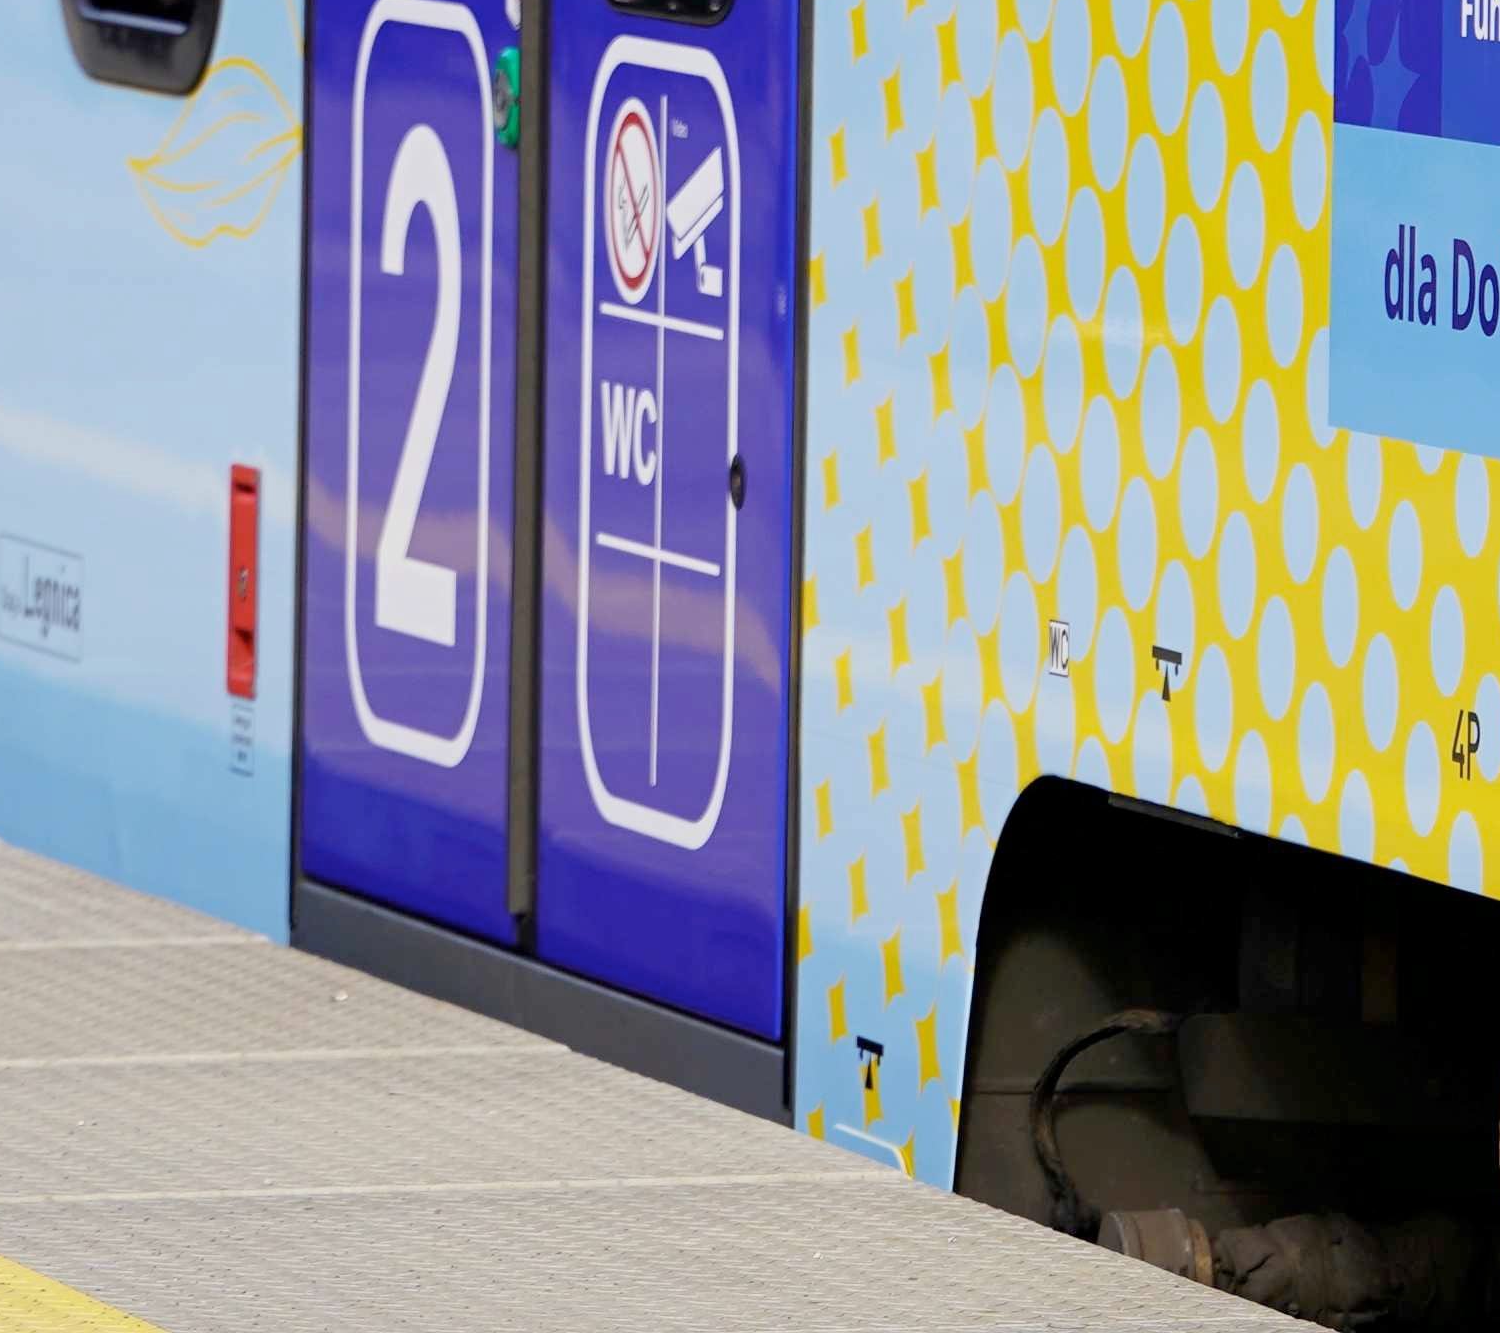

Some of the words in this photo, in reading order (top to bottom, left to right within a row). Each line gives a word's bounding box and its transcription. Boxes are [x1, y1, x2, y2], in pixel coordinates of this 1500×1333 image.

[1384, 223, 1438, 327] dla
[375, 123, 463, 648] 2
[600, 380, 659, 487] WC
[23, 554, 81, 639] Legnica
[1049, 625, 1069, 670] WC
[1452, 709, 1481, 782] 4P
